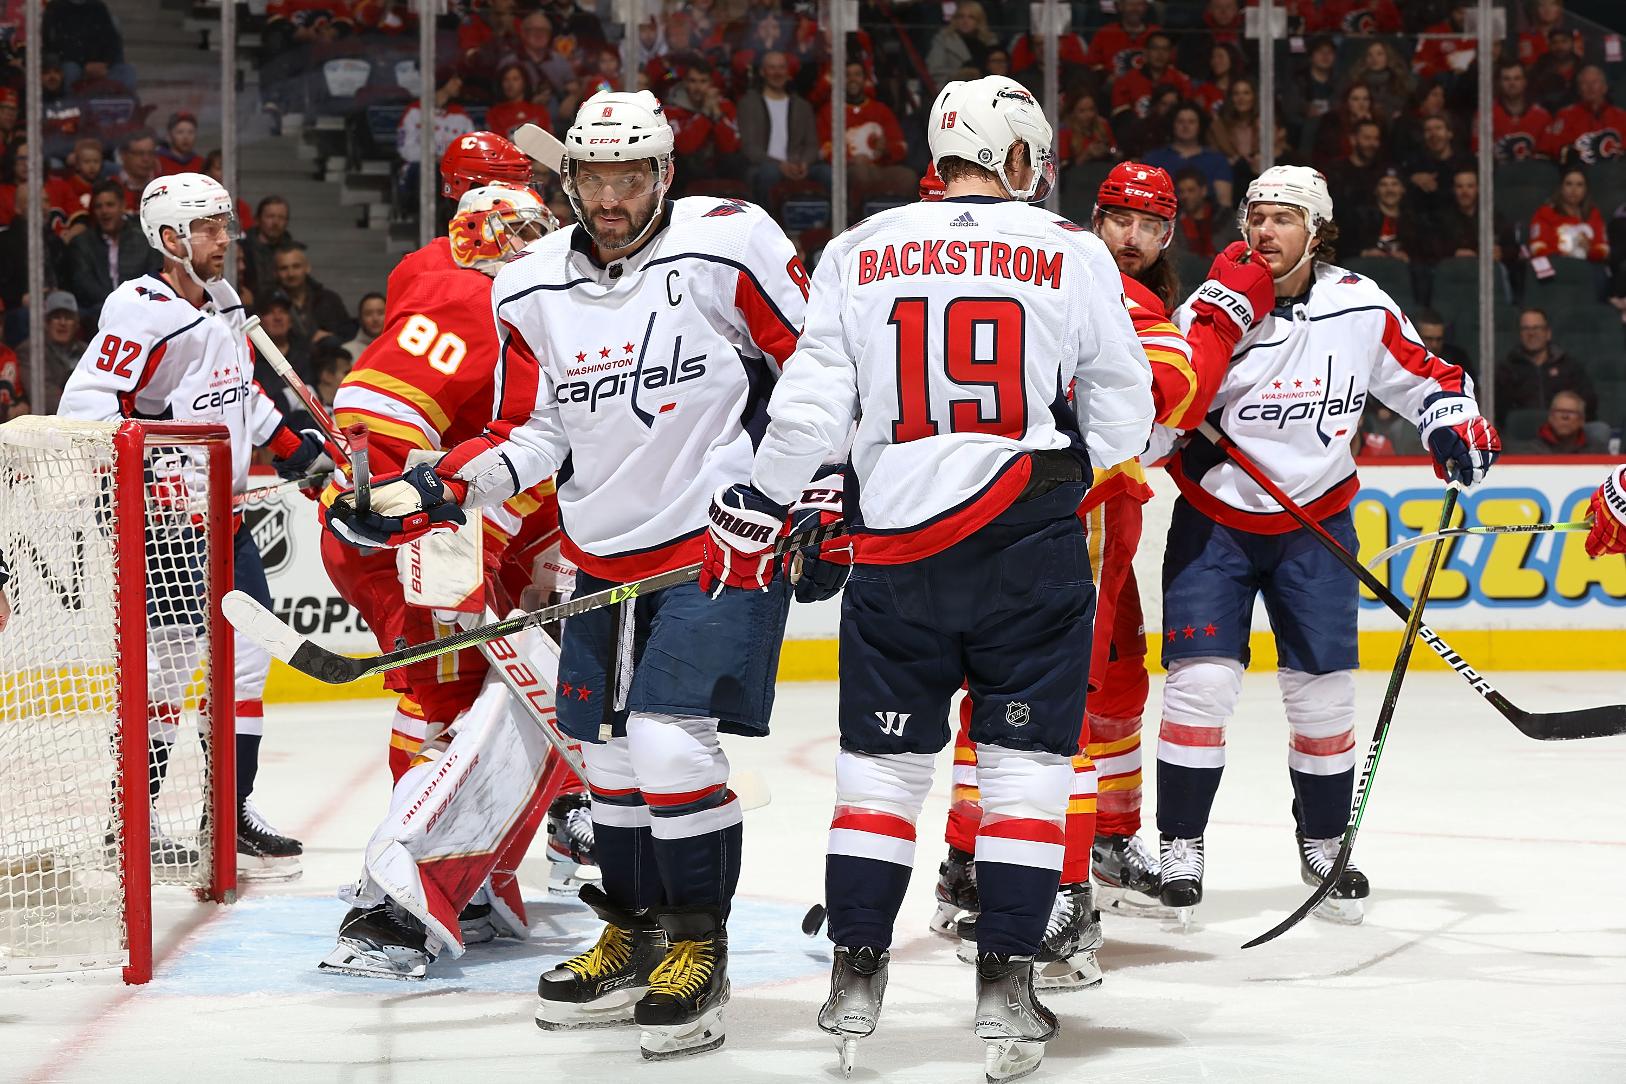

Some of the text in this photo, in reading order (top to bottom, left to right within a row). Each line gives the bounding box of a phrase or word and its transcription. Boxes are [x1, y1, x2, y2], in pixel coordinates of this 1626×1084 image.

[602, 106, 613, 118] 8
[940, 111, 957, 129] 19
[1124, 187, 1154, 199] CCM
[858, 239, 1064, 289] BACKSTROM
[666, 269, 683, 307] C
[96, 334, 142, 379] 92
[397, 313, 468, 376] 80
[566, 358, 634, 378] WASHINGTON
[886, 296, 1029, 445] 19
[1261, 389, 1322, 400] WASHINGTON
[1417, 403, 1464, 436] AUER
[708, 502, 774, 543] RRIOR
[1353, 498, 1626, 600] IZZA
[543, 562, 577, 577] BAUE
